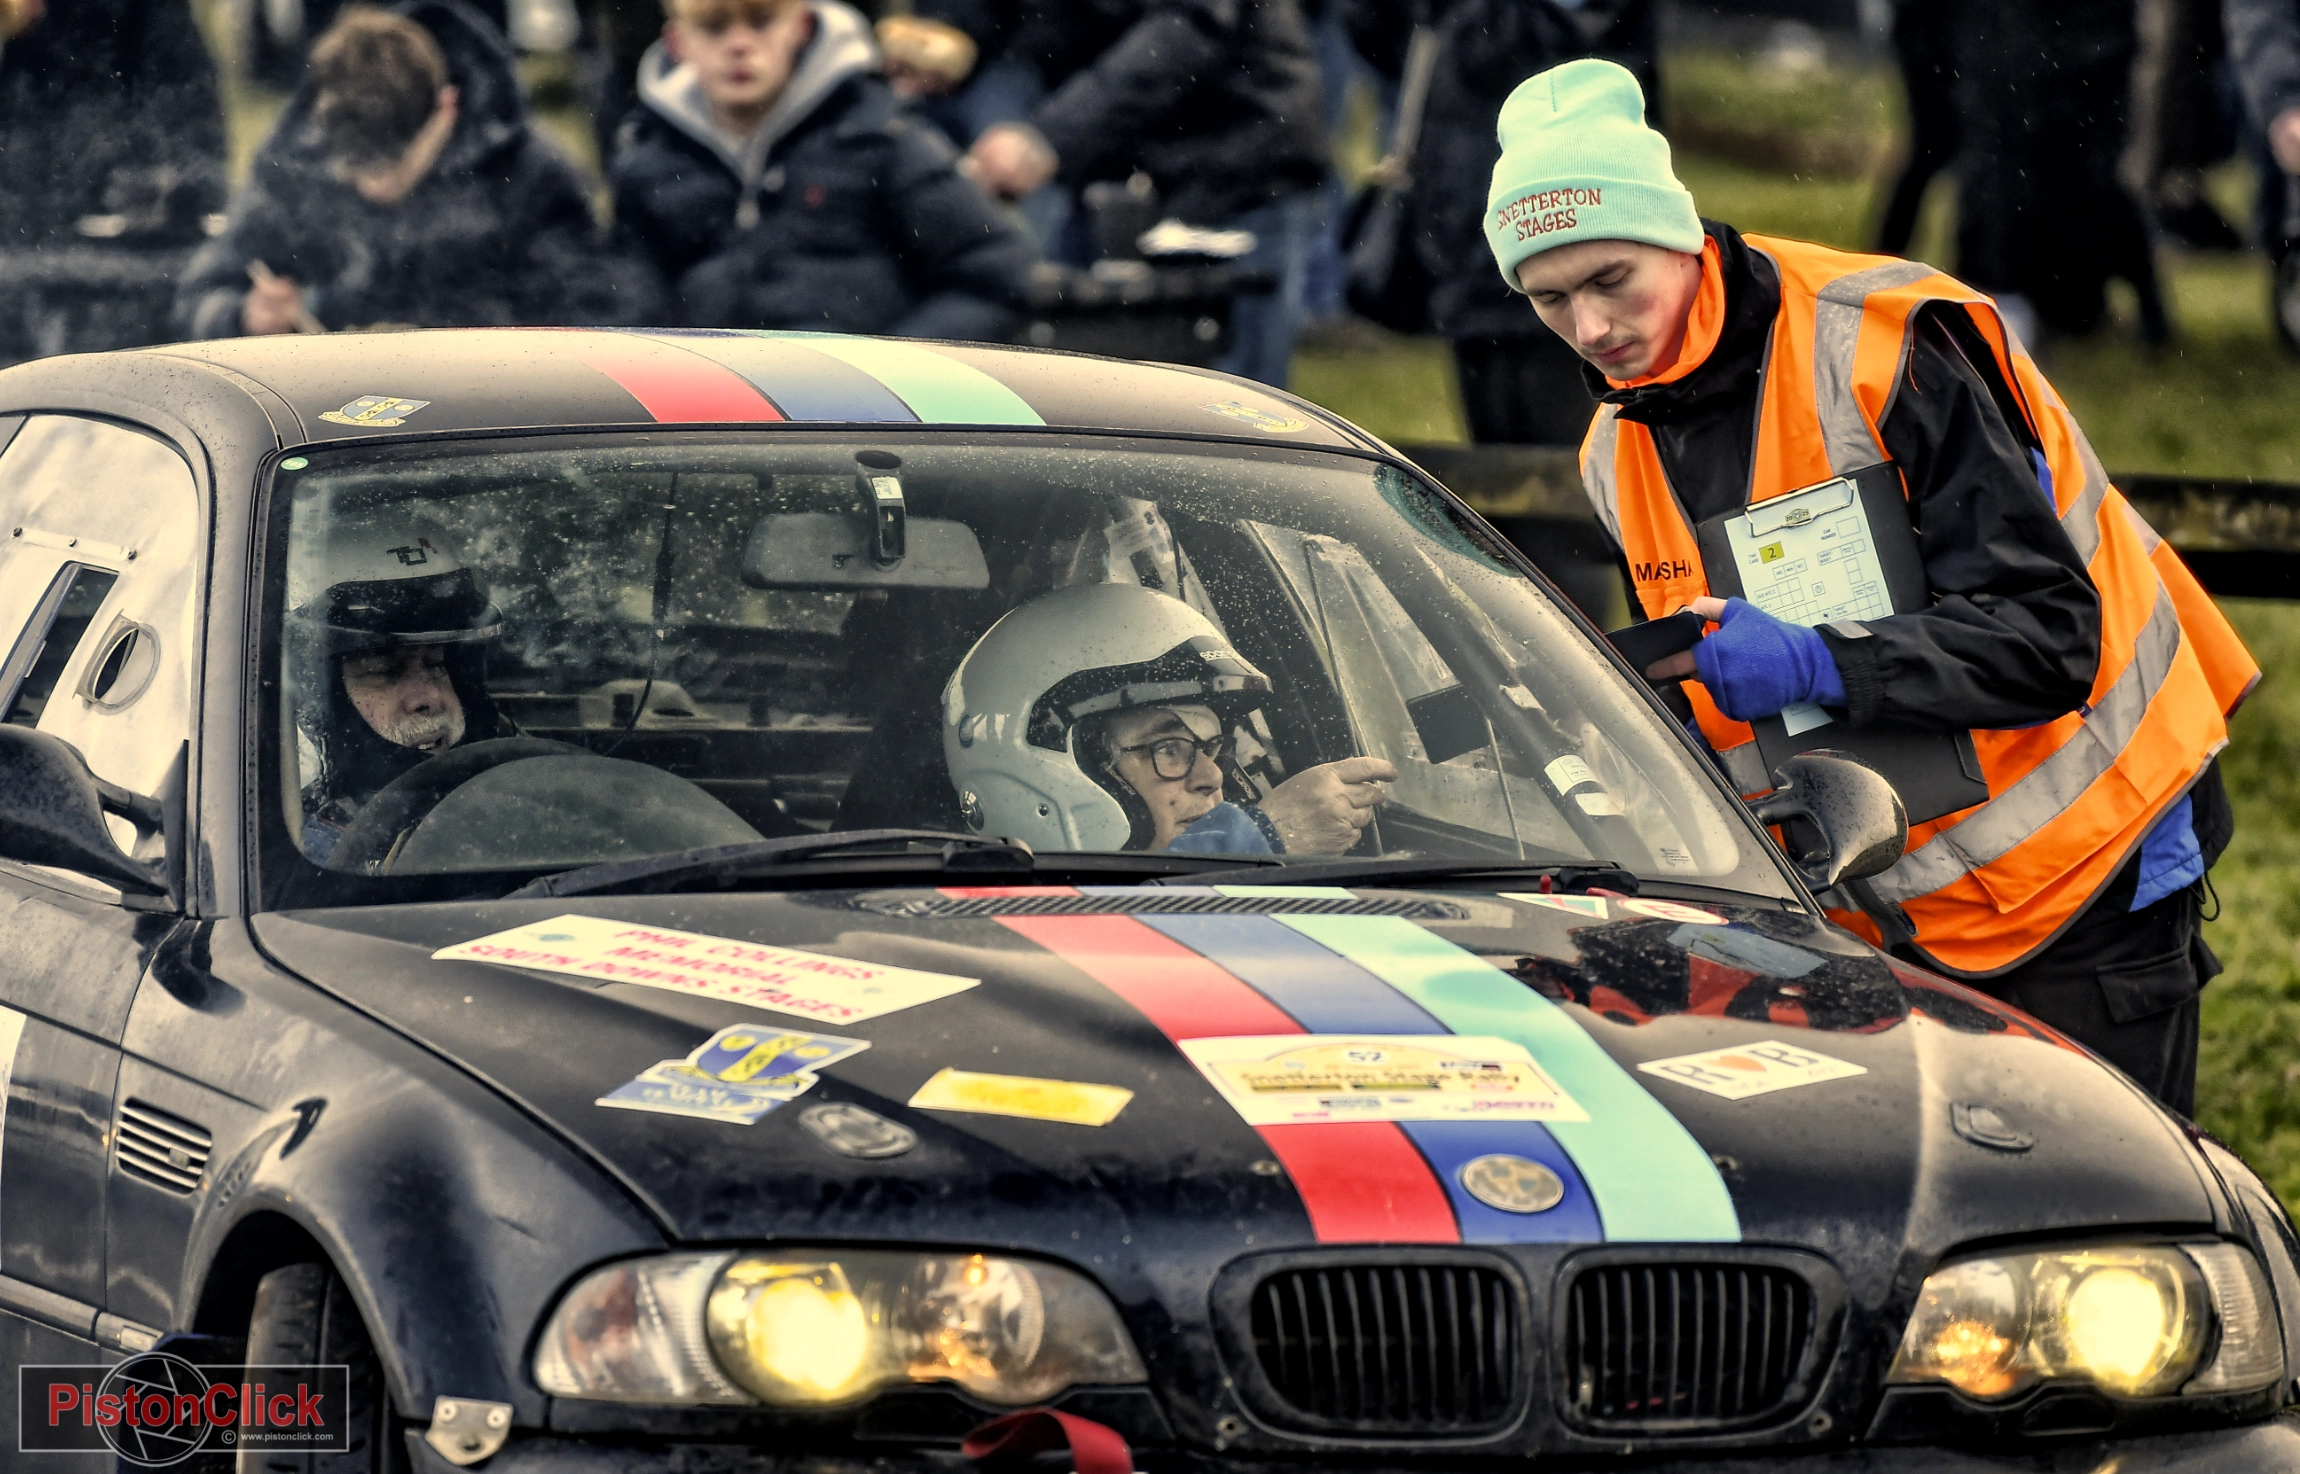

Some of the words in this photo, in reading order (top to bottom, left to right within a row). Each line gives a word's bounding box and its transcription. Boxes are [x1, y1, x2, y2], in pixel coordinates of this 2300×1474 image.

[1497, 188, 1601, 230] SNETTERTON
[1515, 208, 1577, 241] STAGES
[1768, 547, 1777, 559] 2
[604, 946, 799, 985] MEMORIAL
[707, 945, 885, 979] COLLINGS
[459, 945, 582, 966] SOUTH
[717, 985, 864, 1017] STAGES
[1348, 1051, 1385, 1063] 52
[1659, 1063, 1736, 1085] R
[1749, 1048, 1820, 1068] B
